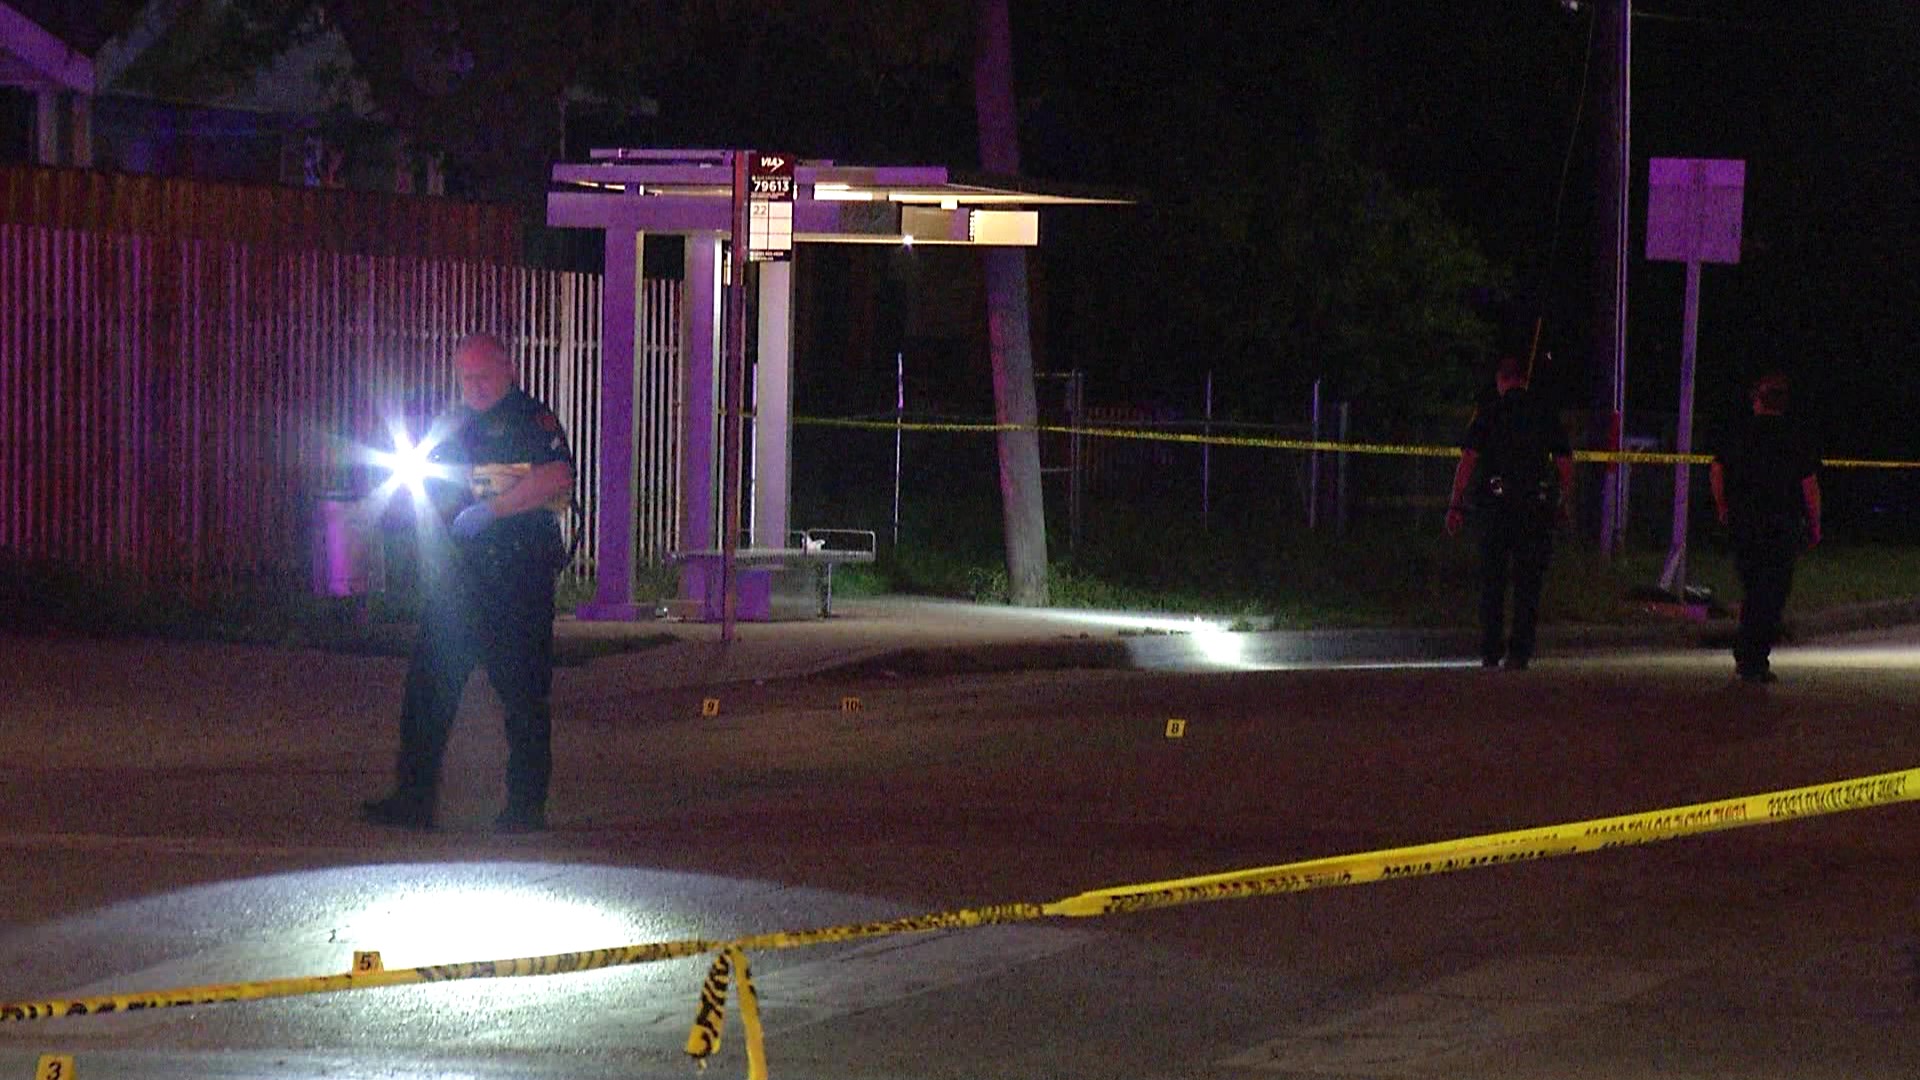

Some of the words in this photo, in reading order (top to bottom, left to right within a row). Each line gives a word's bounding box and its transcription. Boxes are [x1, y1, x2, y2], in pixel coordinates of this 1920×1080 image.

[761, 157, 780, 169] VIA
[754, 181, 790, 192] 79613
[753, 205, 767, 216] 22
[707, 701, 715, 712] 9
[846, 701, 858, 712] 10
[1171, 722, 1180, 734] 8
[360, 954, 371, 971] 5
[46, 1061, 62, 1080] 3
